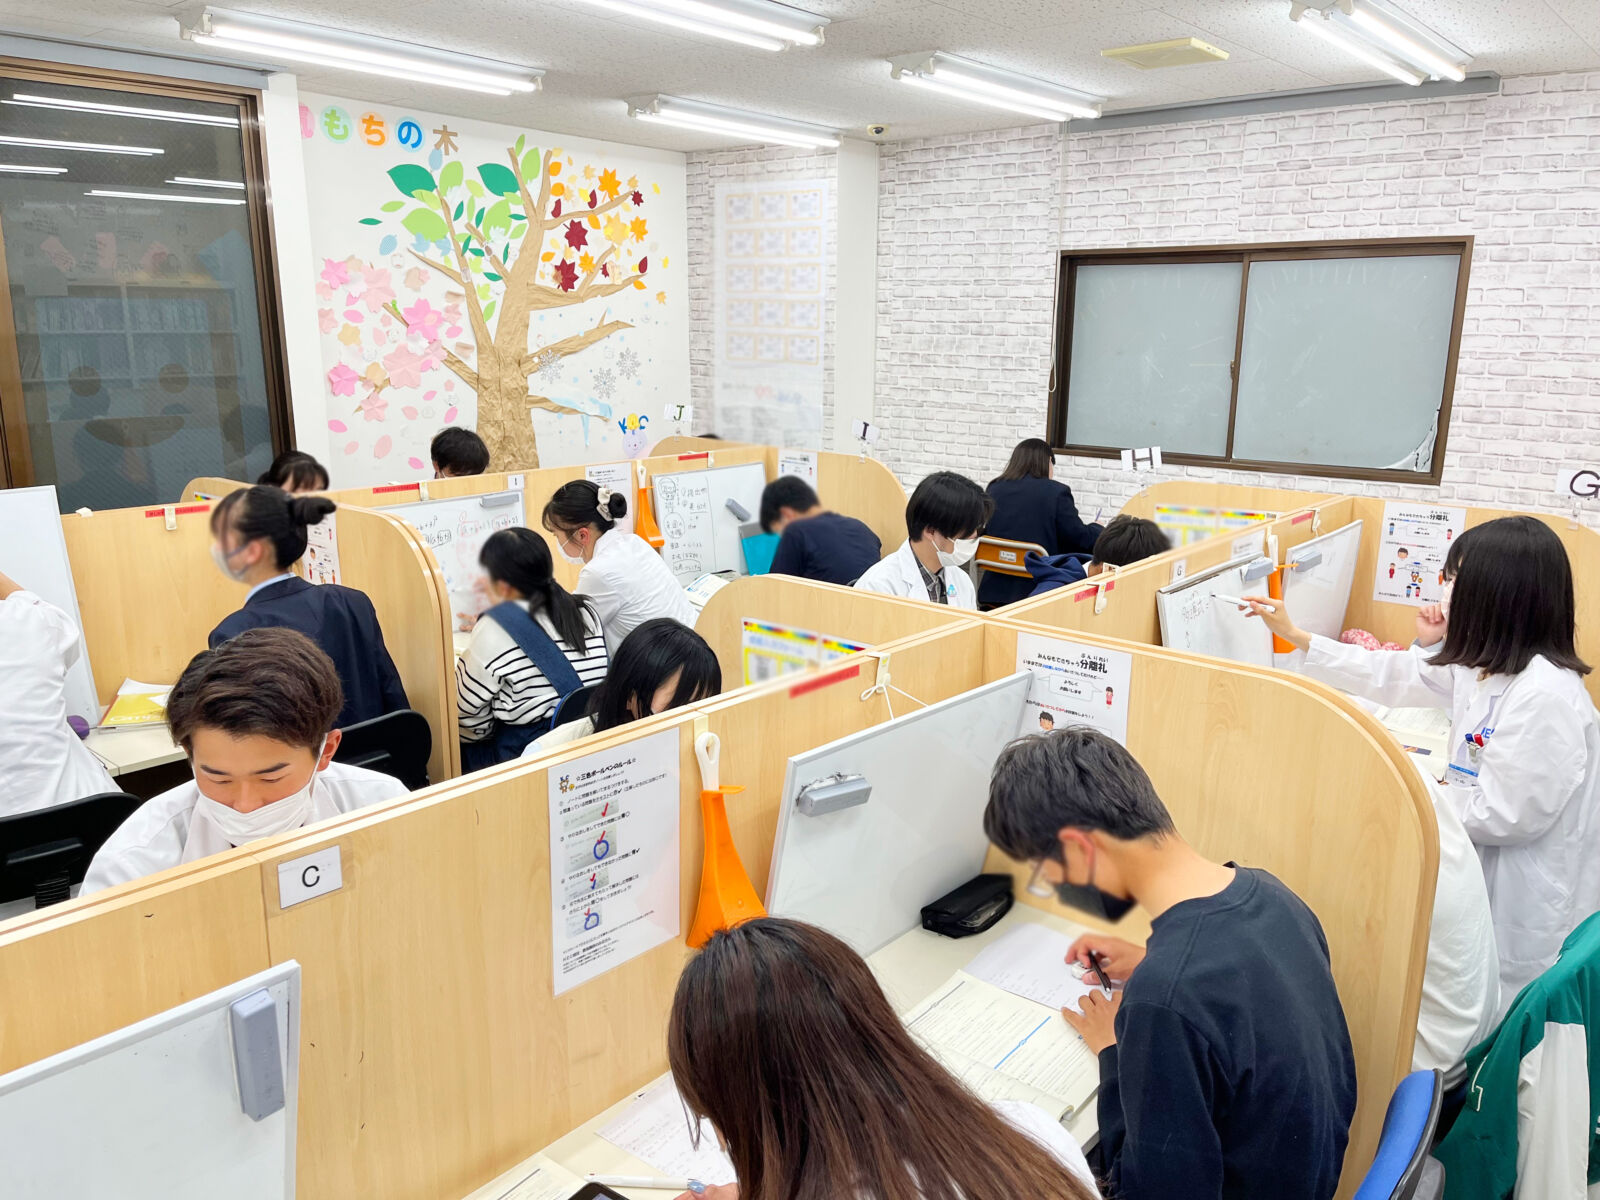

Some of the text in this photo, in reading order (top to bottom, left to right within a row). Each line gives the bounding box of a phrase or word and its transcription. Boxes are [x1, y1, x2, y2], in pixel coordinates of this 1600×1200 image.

[673, 404, 685, 421] J
[860, 421, 870, 440] I
[1131, 447, 1154, 471] H
[1569, 469, 1600, 498] G
[302, 865, 320, 887] C
